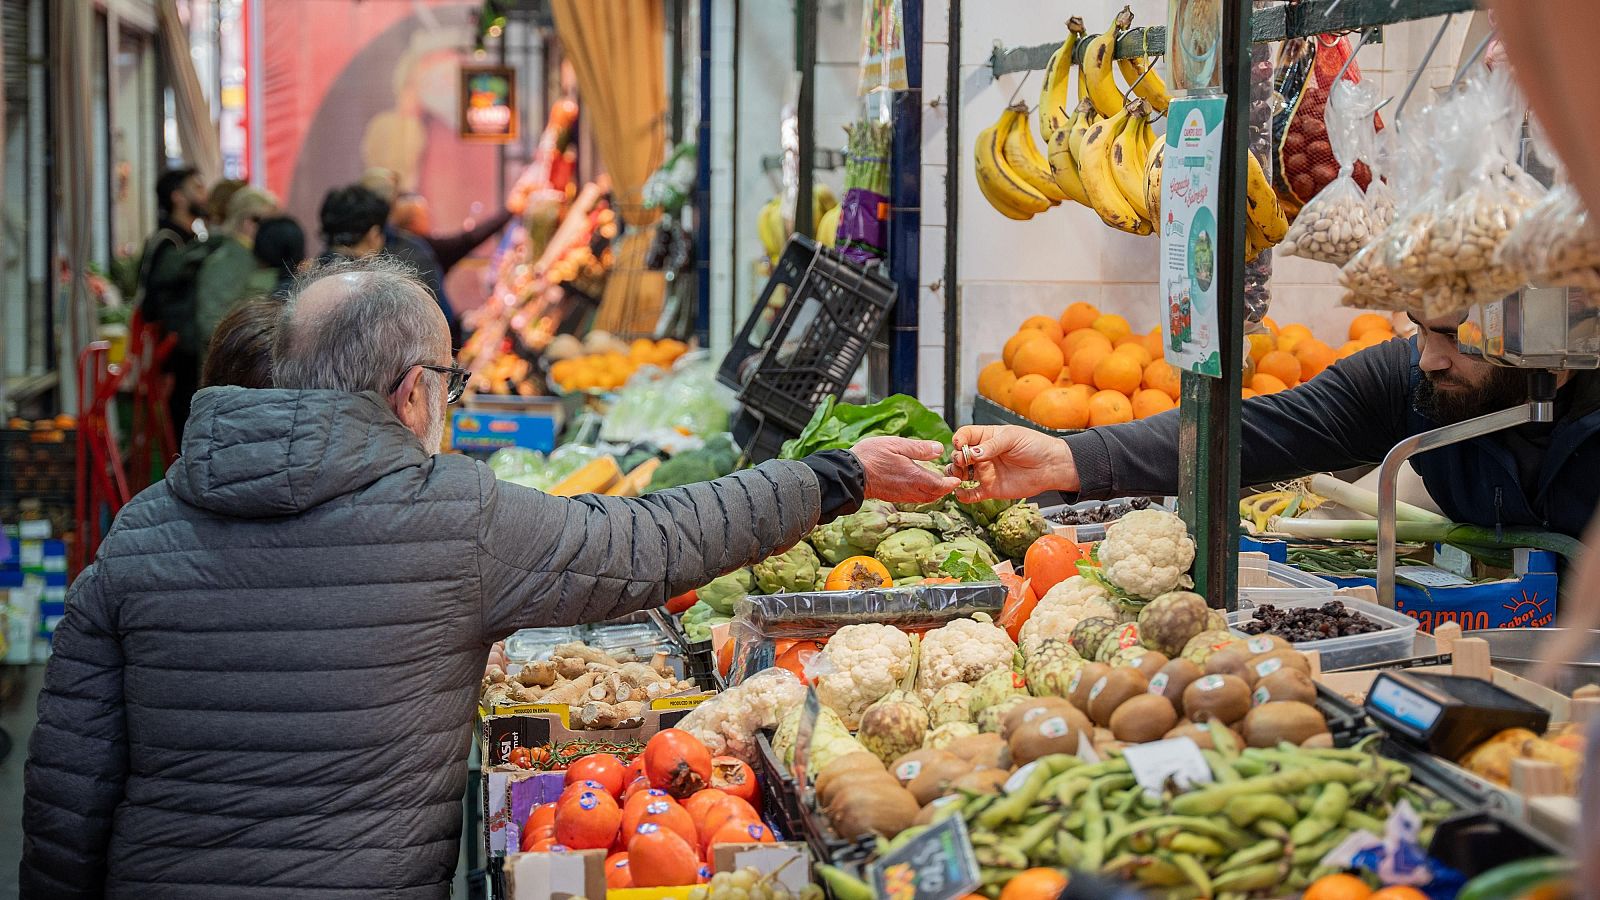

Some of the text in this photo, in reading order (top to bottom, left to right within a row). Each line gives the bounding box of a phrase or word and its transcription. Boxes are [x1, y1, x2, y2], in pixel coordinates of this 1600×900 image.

[1499, 609, 1535, 628] Sabor
[1530, 612, 1553, 628] Sur
[501, 740, 512, 764] ASI
